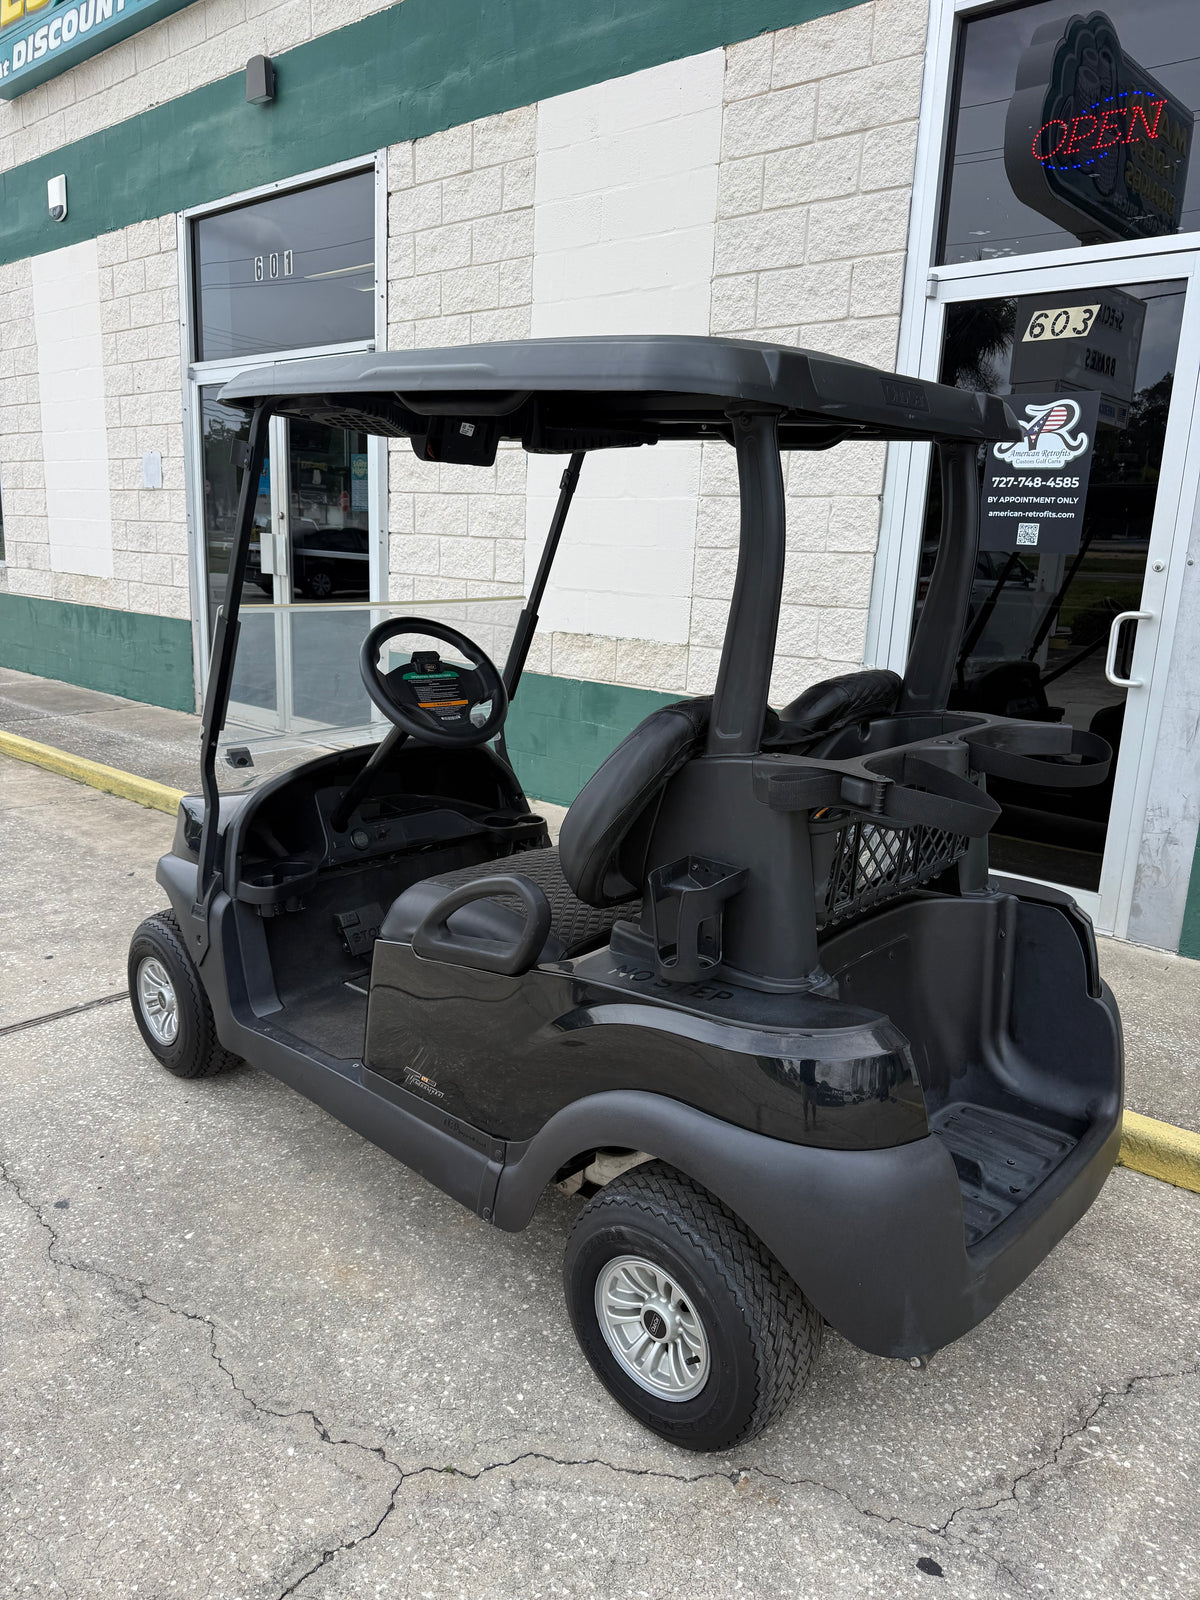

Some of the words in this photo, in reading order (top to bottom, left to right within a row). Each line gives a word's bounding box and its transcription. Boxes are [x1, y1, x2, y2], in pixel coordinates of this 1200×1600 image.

[0, 60, 10, 79] t
[1031, 99, 1168, 160] OPEN
[255, 250, 292, 281] 601
[1029, 308, 1094, 339] 603
[1009, 449, 1040, 458] American
[1041, 448, 1071, 458] Retrofits
[992, 477, 1080, 488] 727-748-4585
[999, 496, 1056, 504] APPOINTMENT
[988, 510, 1075, 518] american-retrofits.com
